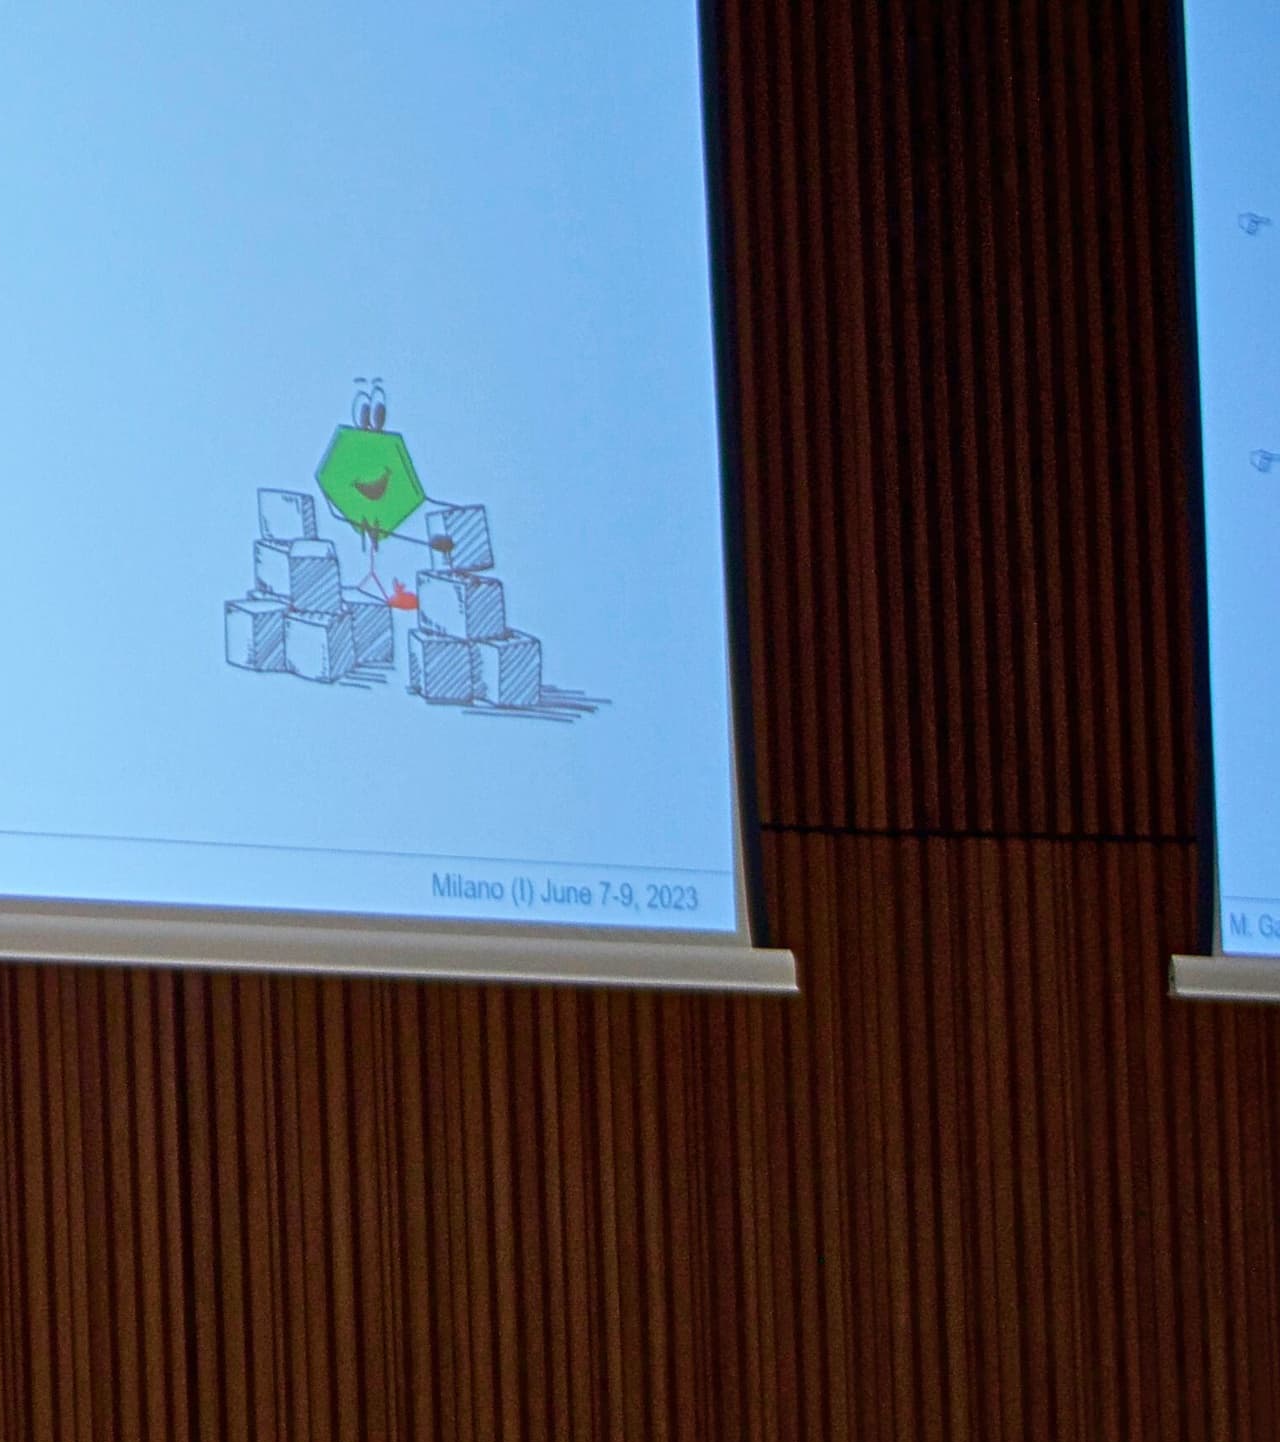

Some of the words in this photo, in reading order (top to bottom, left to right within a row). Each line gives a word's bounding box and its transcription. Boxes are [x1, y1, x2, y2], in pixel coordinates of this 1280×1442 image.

[432, 872, 504, 901] Milano
[540, 878, 592, 905] June
[599, 881, 641, 911] 7-9,
[646, 883, 699, 911] 2023
